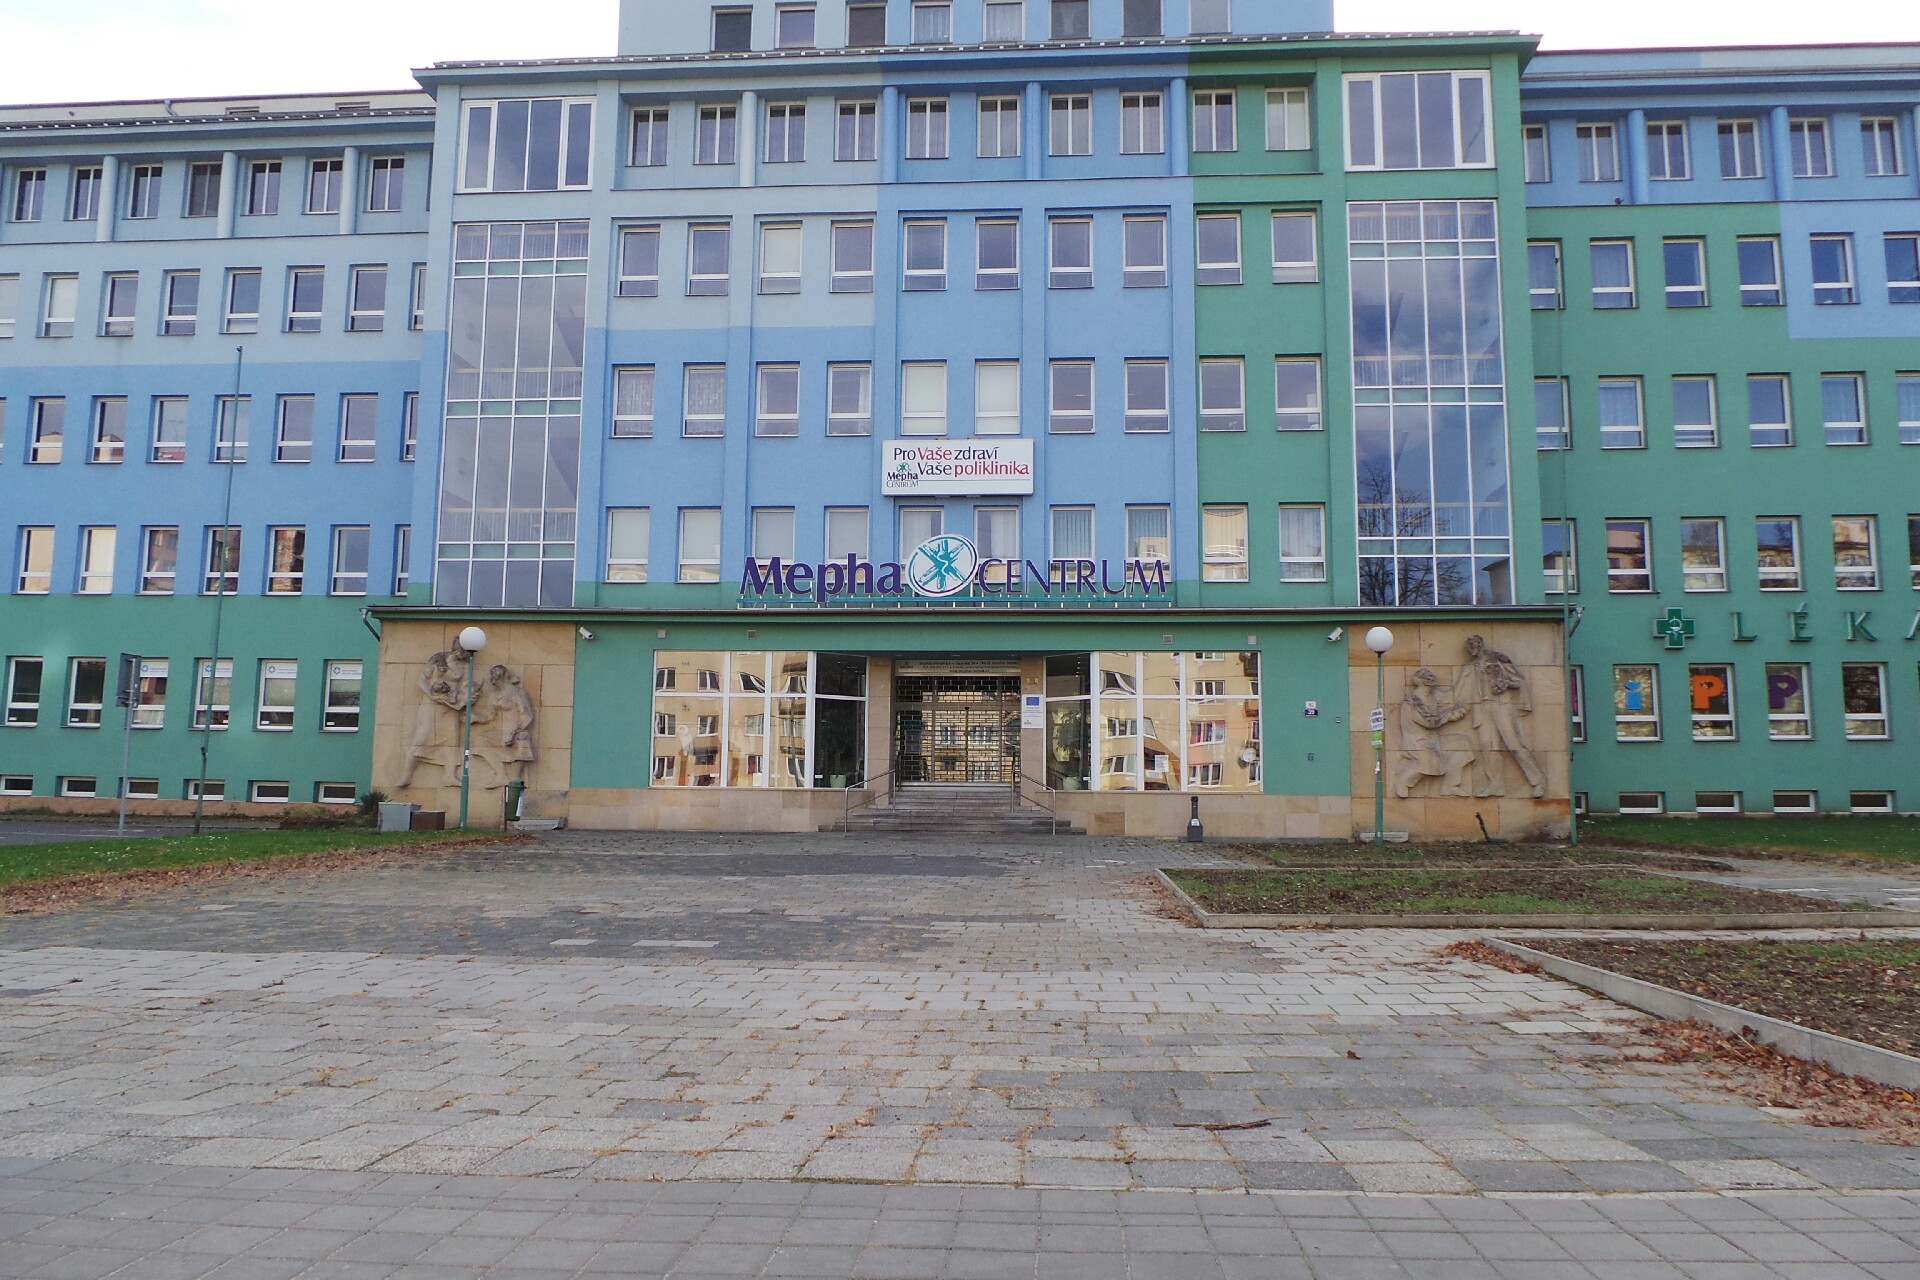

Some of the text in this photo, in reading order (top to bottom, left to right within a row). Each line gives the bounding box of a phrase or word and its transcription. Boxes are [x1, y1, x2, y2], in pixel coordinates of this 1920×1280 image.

[894, 446, 999, 461] Pro Vaše zdraví
[886, 471, 918, 481] Mepha
[917, 461, 1029, 477] Vaše poliklinika
[739, 552, 1166, 603] Mepha CENTRUM
